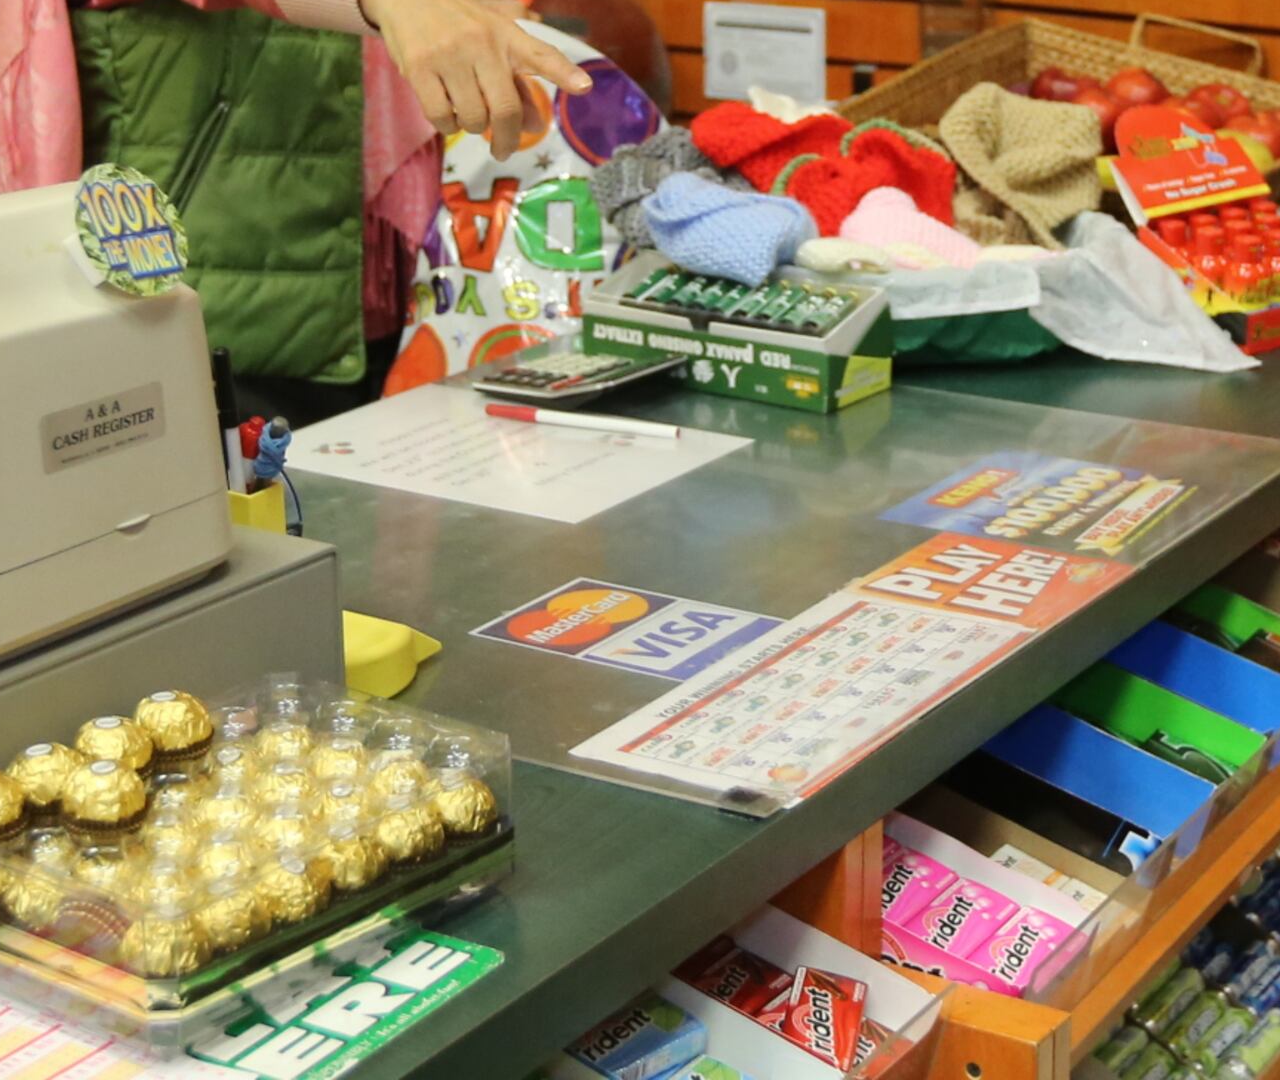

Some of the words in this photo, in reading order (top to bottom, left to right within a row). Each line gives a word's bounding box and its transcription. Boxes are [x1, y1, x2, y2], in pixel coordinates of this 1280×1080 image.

[80, 178, 169, 239] 100X
[125, 232, 181, 275] MONEY
[592, 323, 644, 346] EXTRACT
[647, 333, 704, 356] GINSENG
[705, 342, 755, 364] PANAX
[760, 350, 791, 370] RED
[52, 427, 90, 451] CASH
[93, 406, 155, 439] REGISTER
[84, 407, 95, 422] A
[97, 403, 108, 418] &
[111, 400, 121, 414] A
[867, 542, 1004, 600] PLAY
[950, 548, 1069, 616] HERE!
[524, 587, 631, 647] MasterCard
[625, 608, 737, 660] VISA
[926, 893, 974, 949] rident
[992, 924, 1040, 982] rident
[578, 1008, 652, 1063] rident
[809, 985, 830, 1054] rident
